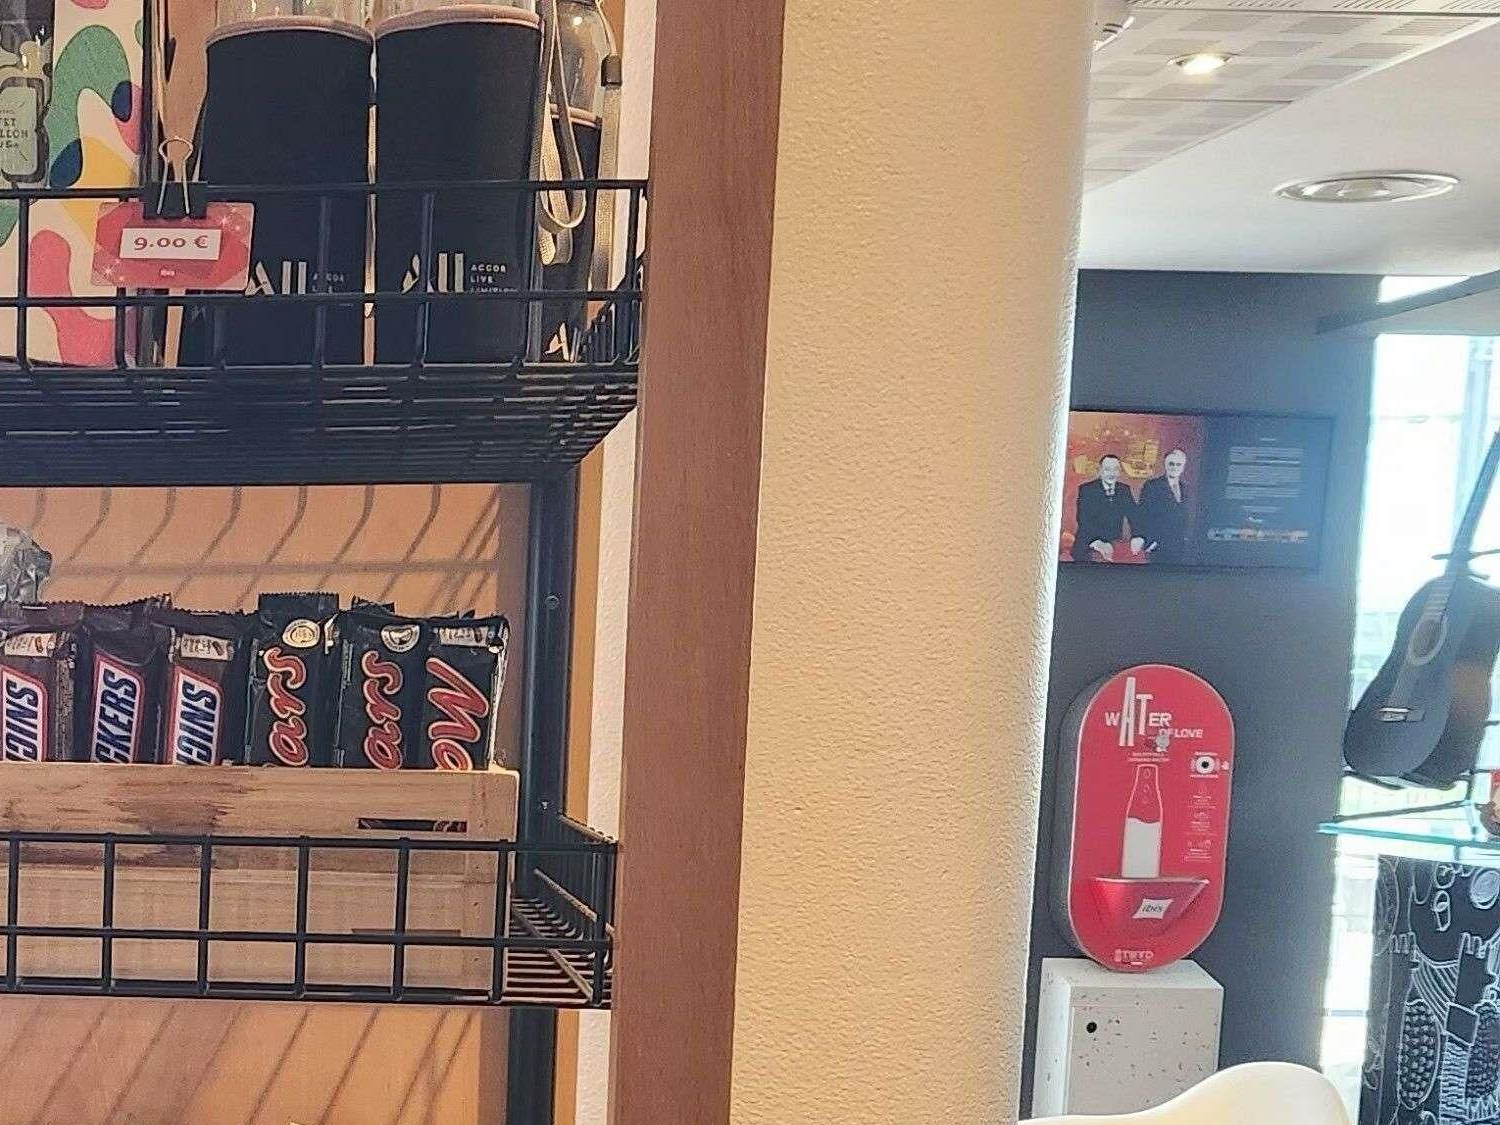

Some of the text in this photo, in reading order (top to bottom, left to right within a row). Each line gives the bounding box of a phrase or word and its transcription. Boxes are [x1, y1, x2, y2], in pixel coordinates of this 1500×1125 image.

[133, 235, 209, 251] 9.00 €
[470, 263, 507, 274] ACCOR
[470, 275, 494, 284] LIVE
[5, 678, 39, 762] SNIC
[94, 668, 138, 763] CKERS
[175, 680, 218, 764] SNIC
[263, 645, 309, 767] ars
[361, 649, 404, 770] ars
[425, 656, 490, 771] Ma
[1174, 728, 1204, 739] LOVE
